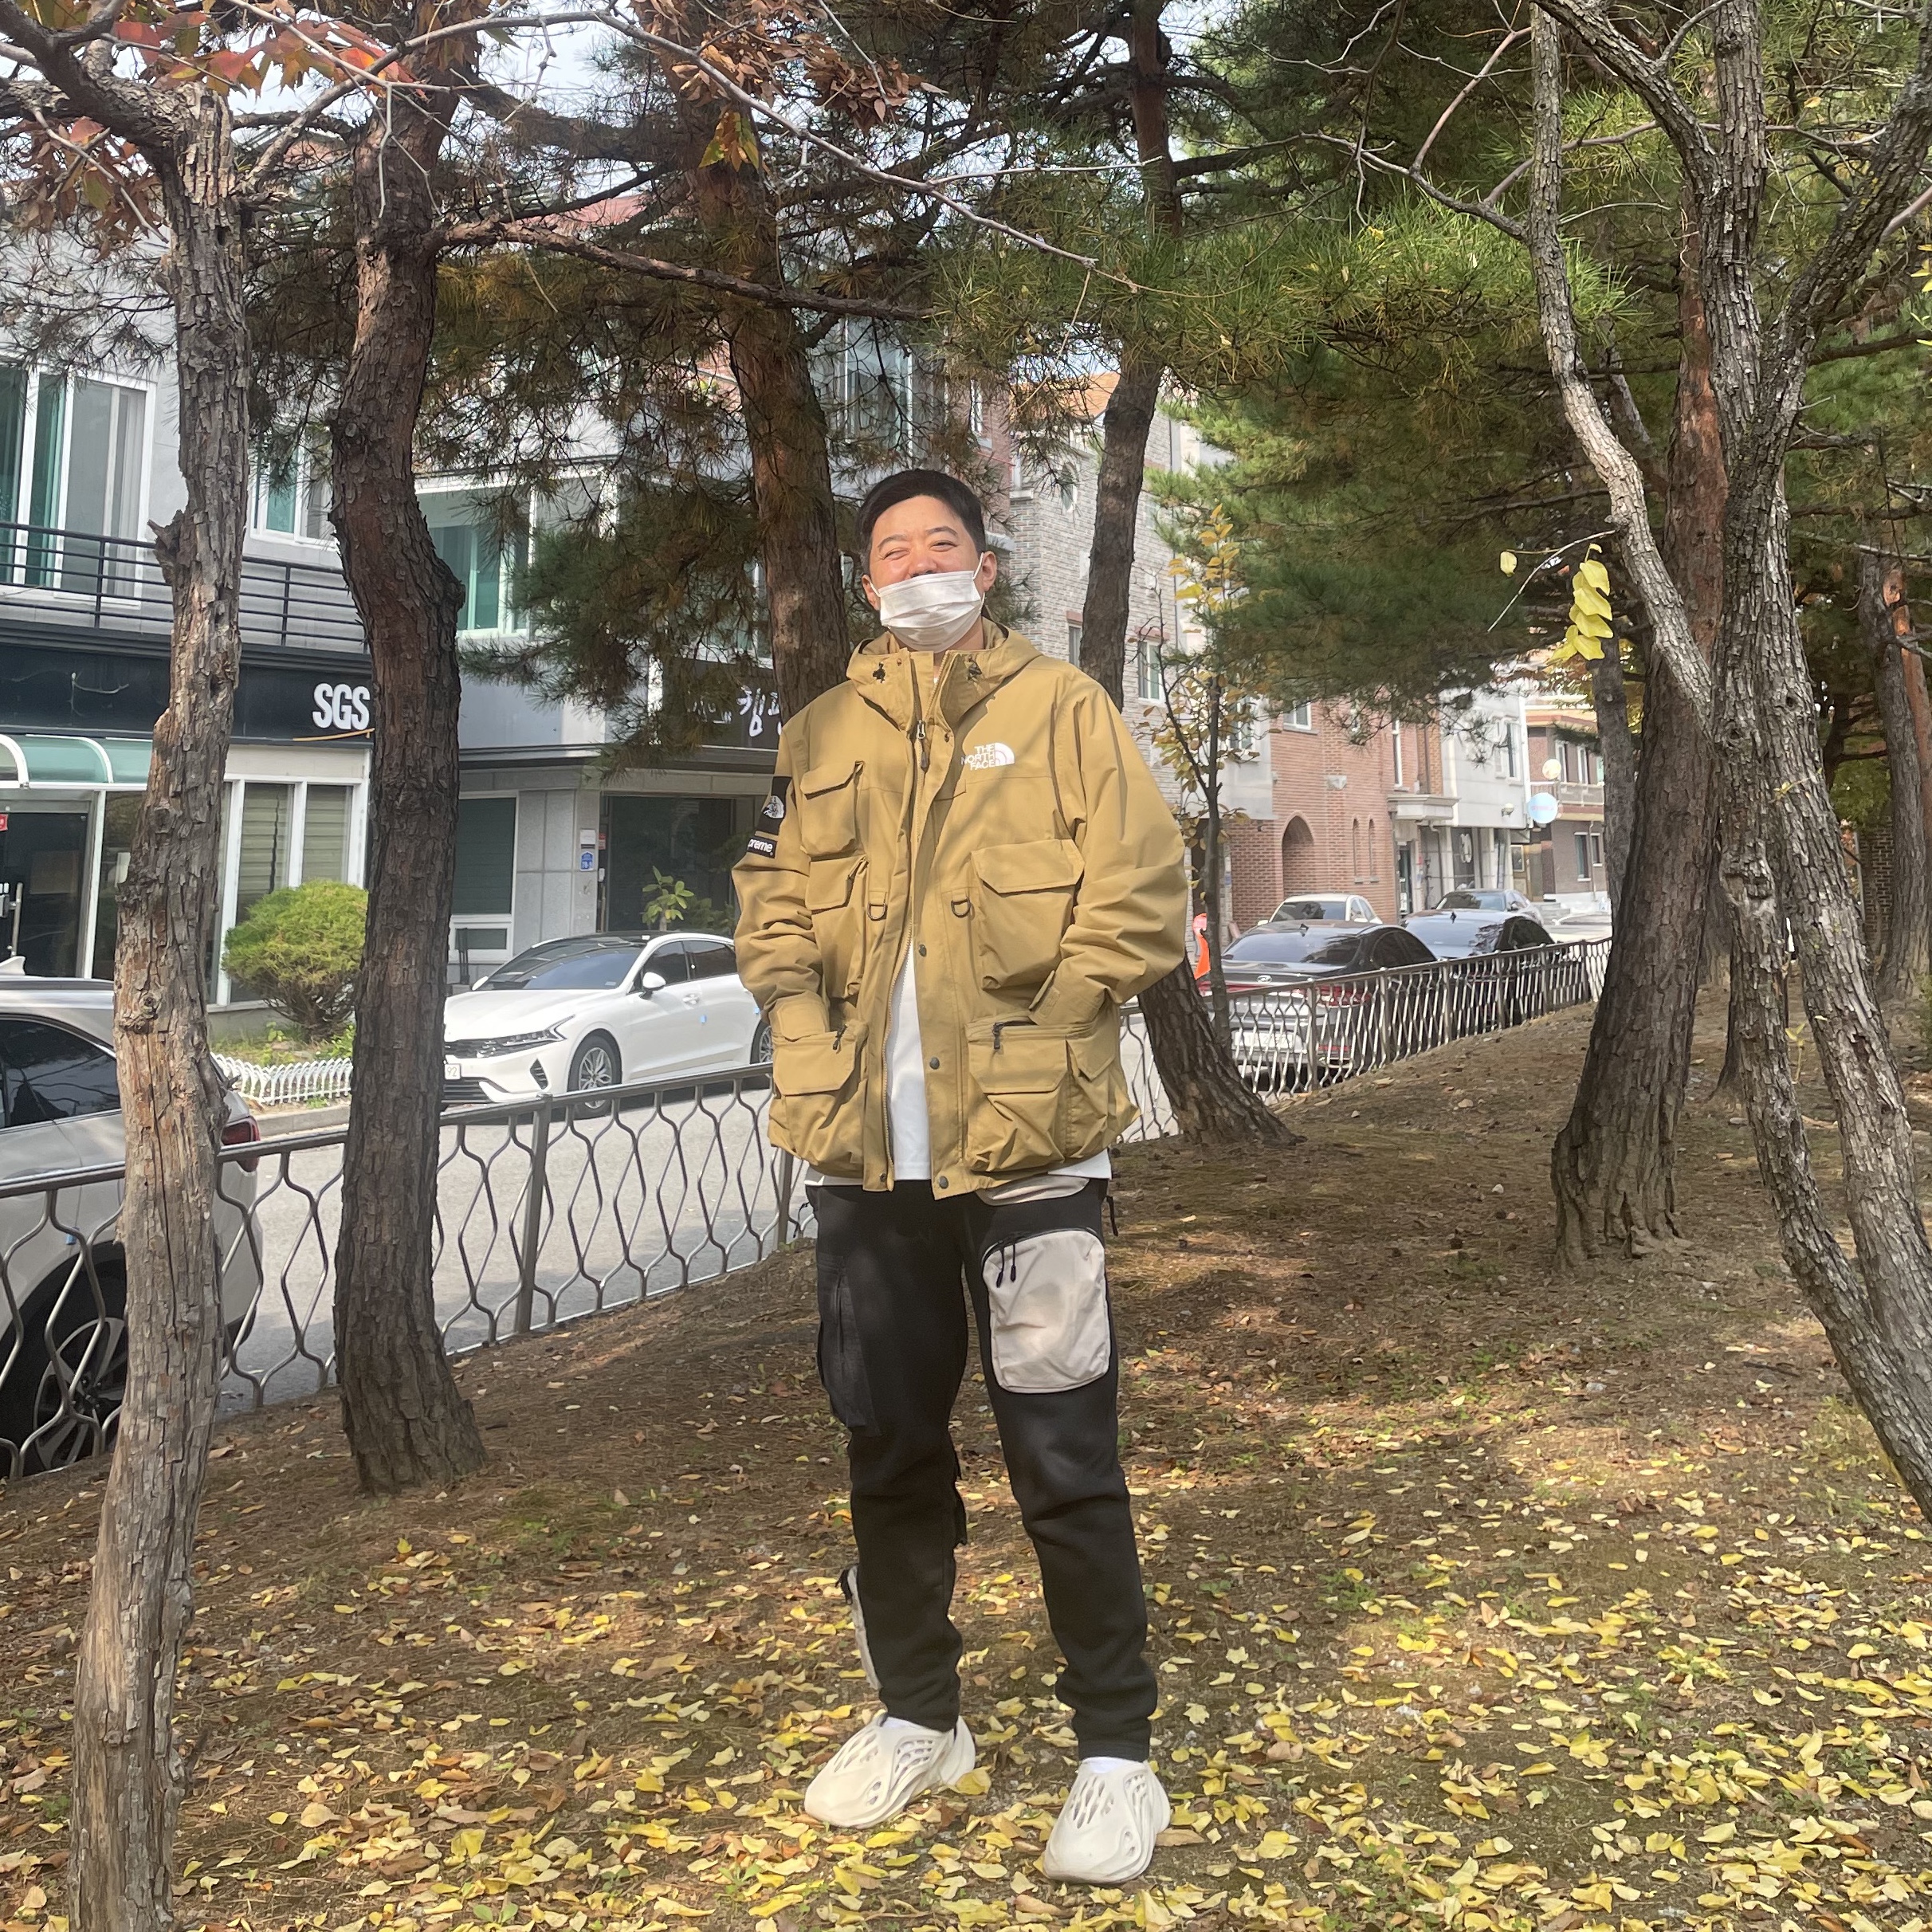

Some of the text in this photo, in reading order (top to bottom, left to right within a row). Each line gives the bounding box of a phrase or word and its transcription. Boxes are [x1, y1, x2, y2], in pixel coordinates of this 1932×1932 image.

[312, 682, 371, 731] SGS
[974, 744, 995, 755] THE
[960, 753, 995, 765] NORTH
[970, 760, 995, 771] FACE
[447, 1066, 457, 1077] 92
